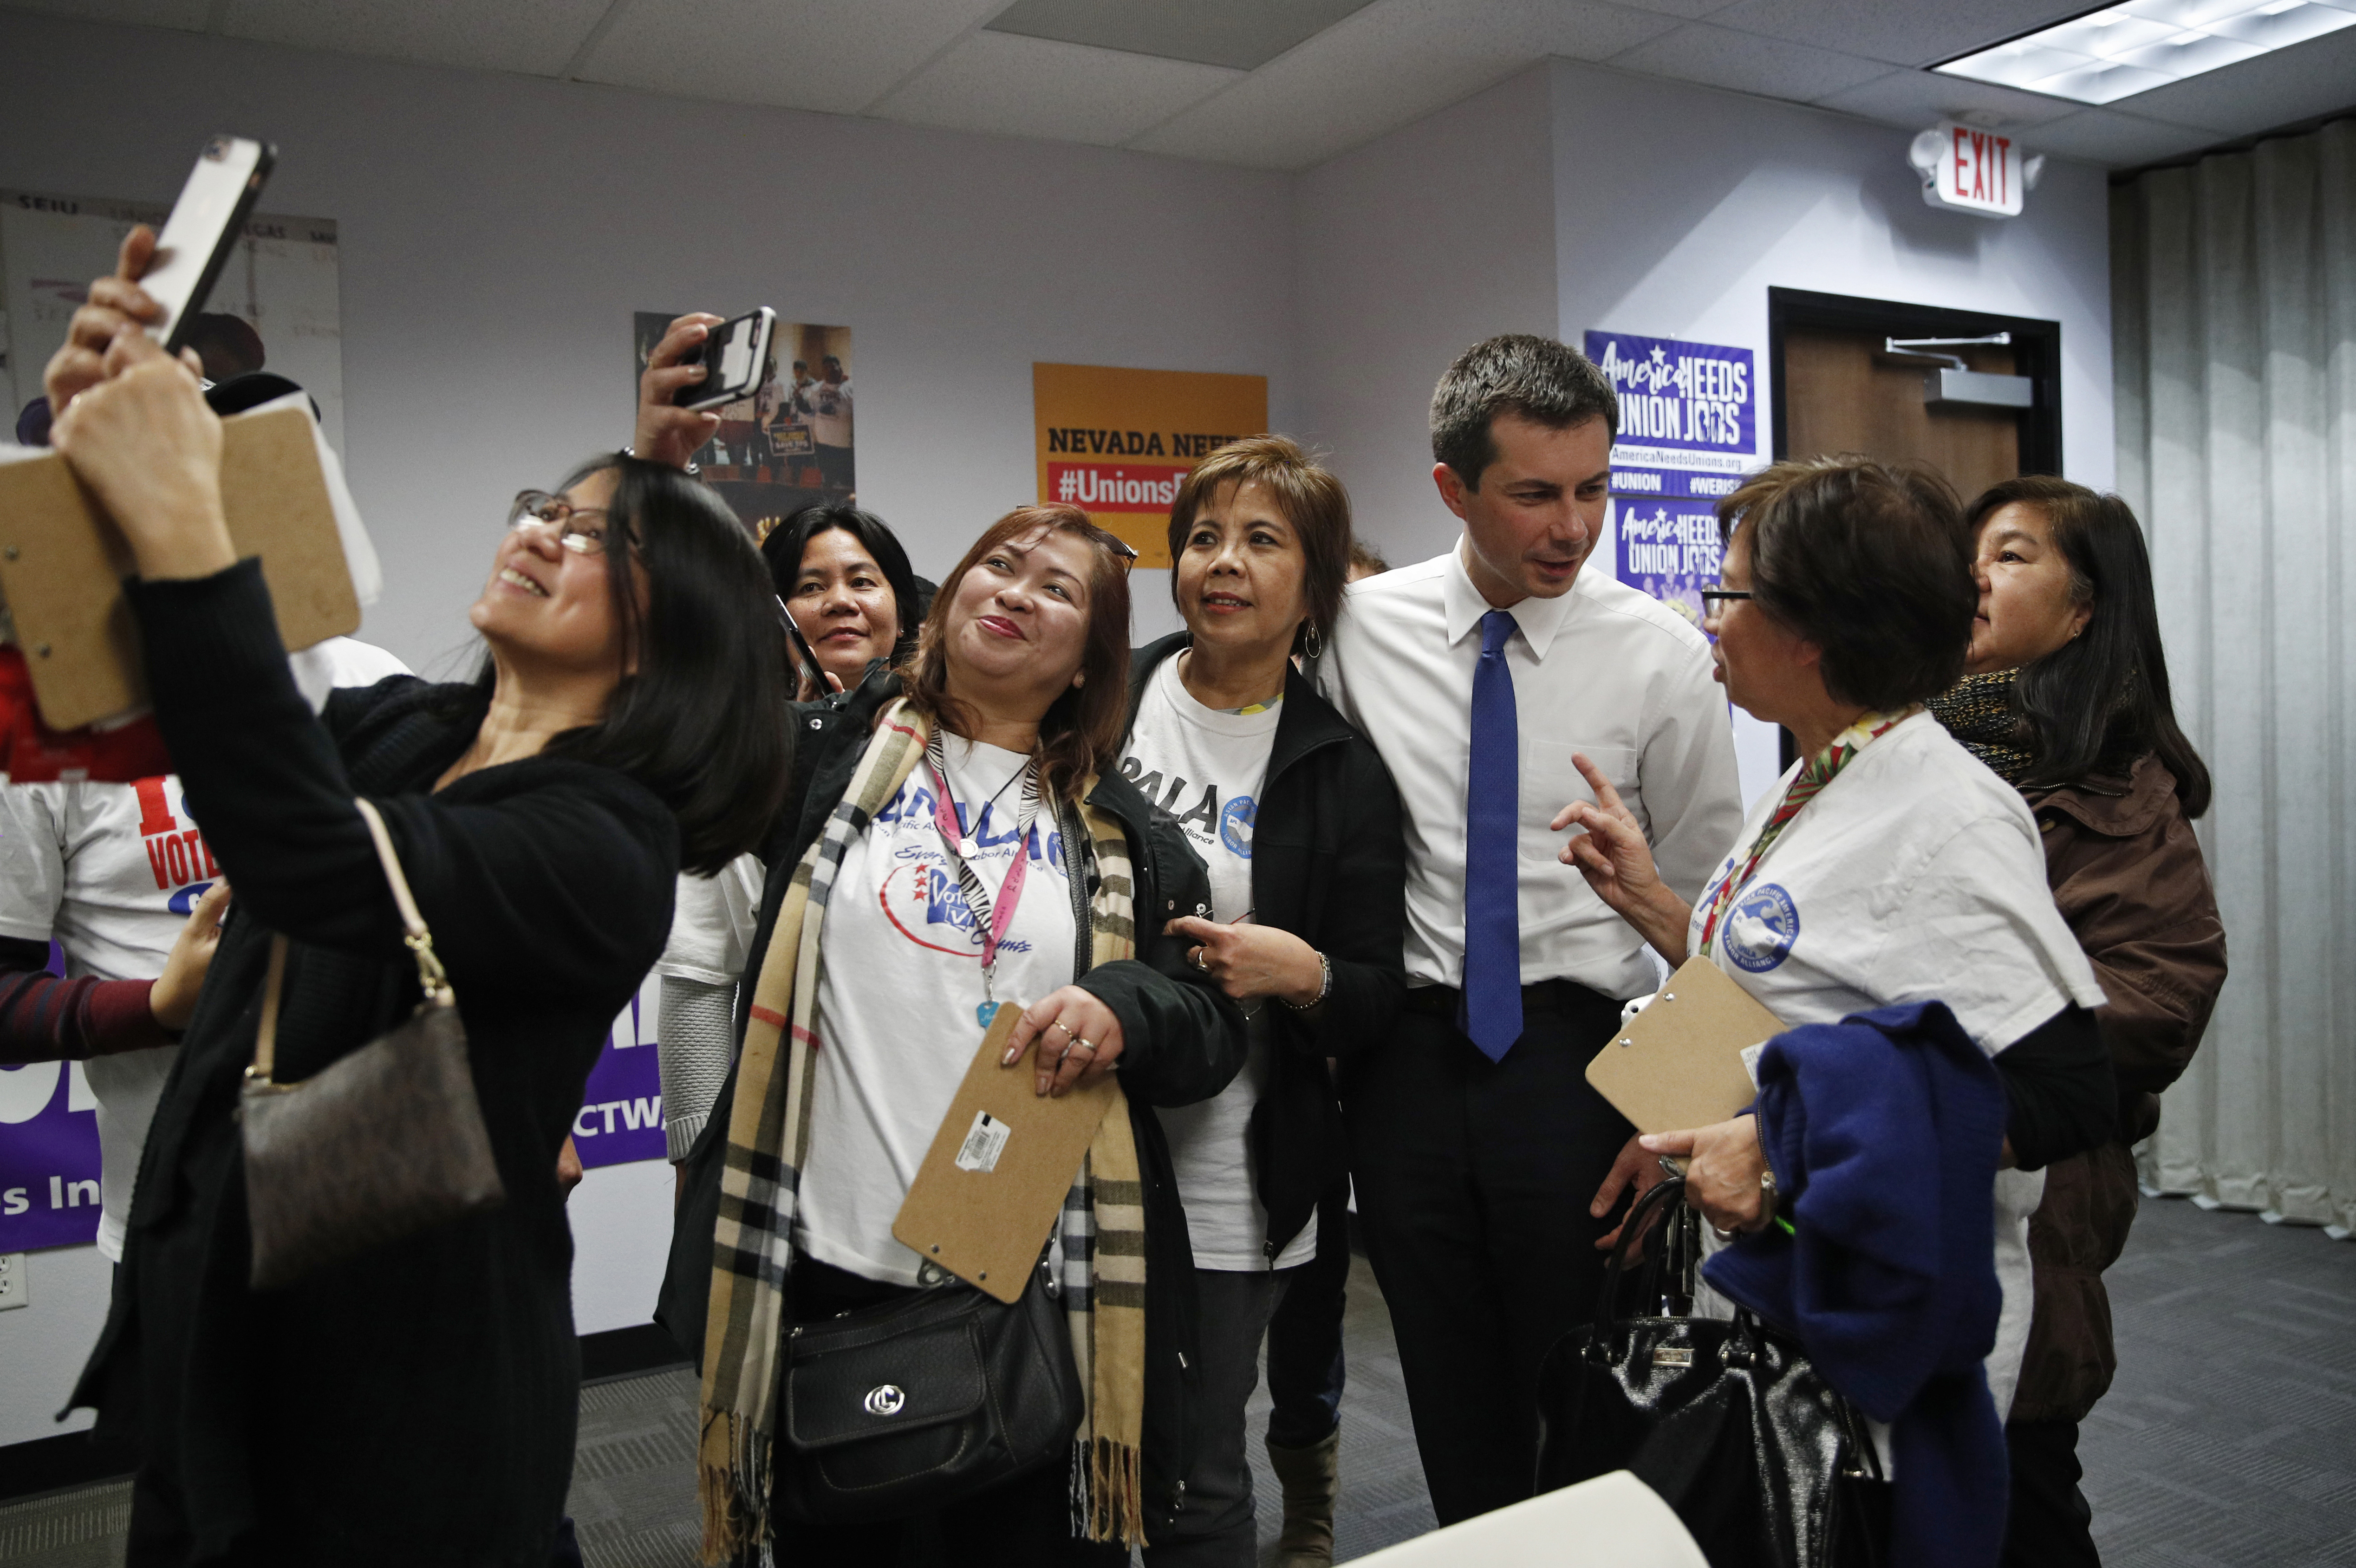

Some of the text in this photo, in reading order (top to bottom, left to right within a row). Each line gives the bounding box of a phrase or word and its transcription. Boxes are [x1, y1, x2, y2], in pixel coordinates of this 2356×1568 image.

[1952, 126, 2011, 205] EXIT
[19, 194, 78, 215] SEIU
[1600, 341, 1748, 404] America NEEDS
[1617, 392, 1740, 445] UNION JOBS
[1048, 428, 1254, 457] NEVADA NEE
[1612, 447, 1741, 472] AmericaNeedsUnions.org
[1611, 472, 1662, 492] #UNION
[1621, 507, 1684, 552] America
[1628, 543, 1721, 576] UNION JOBS
[130, 775, 177, 837] I
[1224, 803, 1238, 817] ASIAN
[895, 845, 948, 865] Every
[971, 851, 1000, 860] abor
[1224, 833, 1237, 849] LABOR
[1757, 887, 1782, 900] PACIFIC
[1725, 934, 1776, 969] LABOR ALLIANCE
[572, 1095, 667, 1138] CTW
